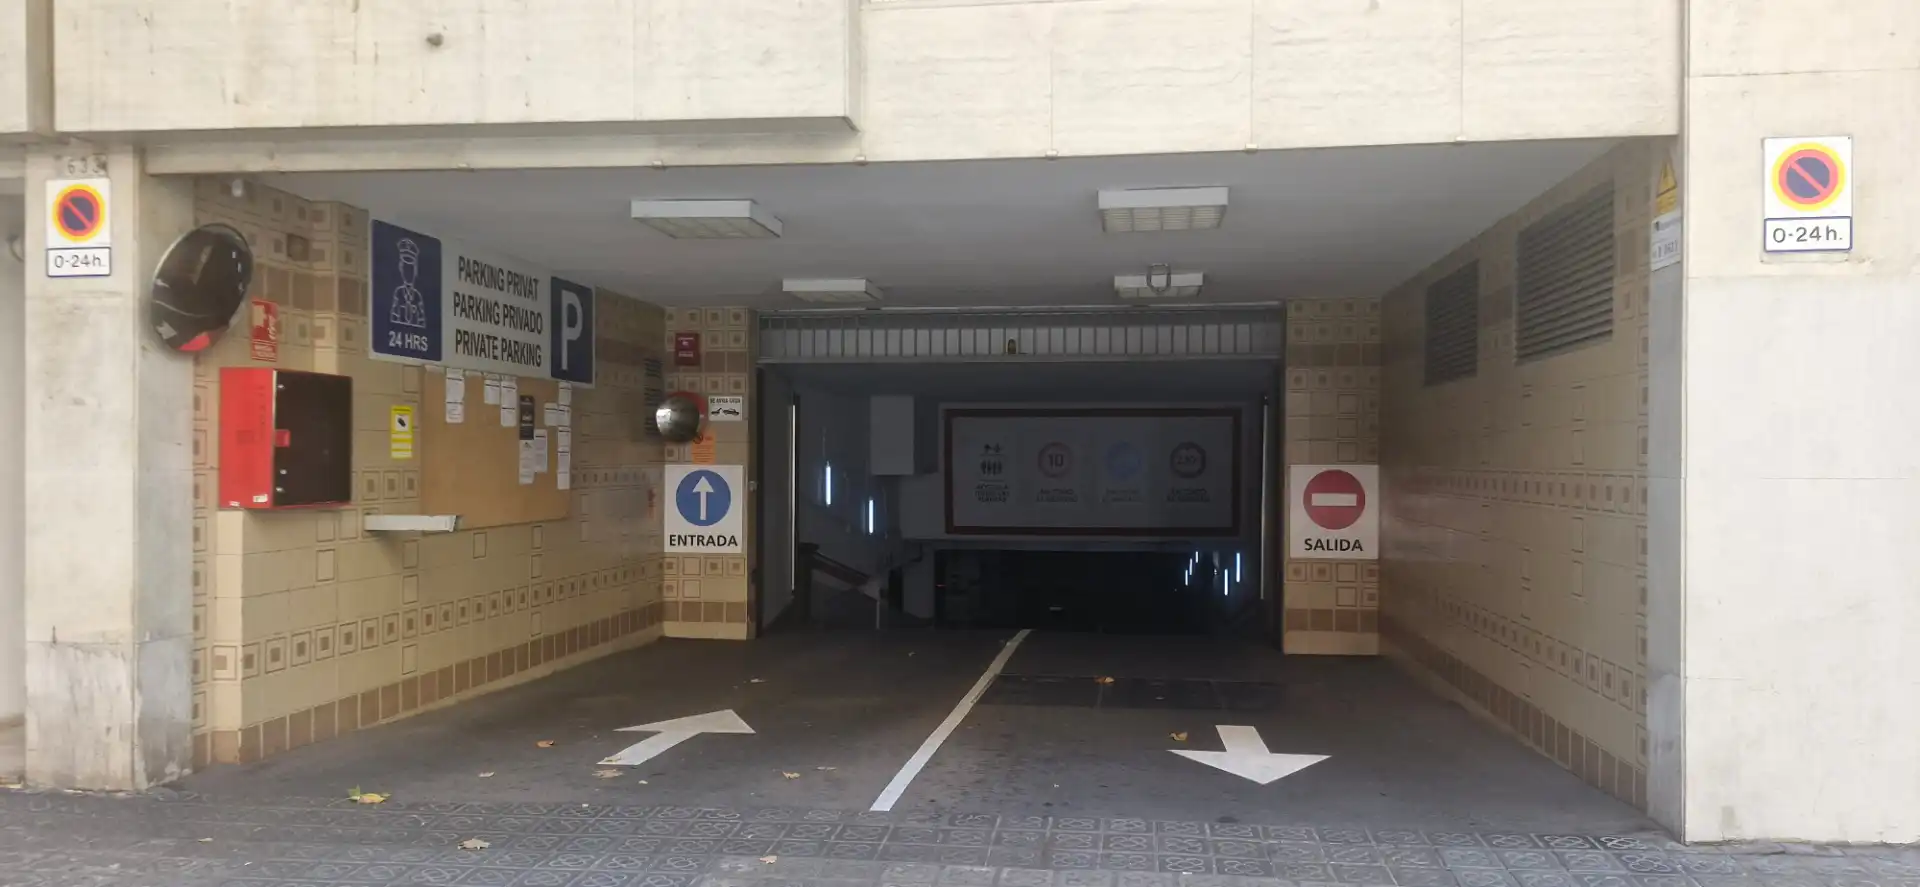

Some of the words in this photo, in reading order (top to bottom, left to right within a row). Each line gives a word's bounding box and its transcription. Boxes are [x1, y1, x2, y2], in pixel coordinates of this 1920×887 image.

[458, 255, 504, 292] PARKING
[507, 270, 540, 301] PRIVAT
[453, 291, 500, 326] PARKING
[502, 303, 543, 336] PRIVADO
[388, 330, 402, 348] 24
[404, 332, 428, 352] HRS
[561, 289, 584, 371] P
[455, 328, 498, 361] PRIVATE
[501, 338, 543, 368] PARKING
[1048, 453, 1064, 467] 10
[669, 534, 738, 547] ENTRADA
[1304, 537, 1364, 552] SALIDA
